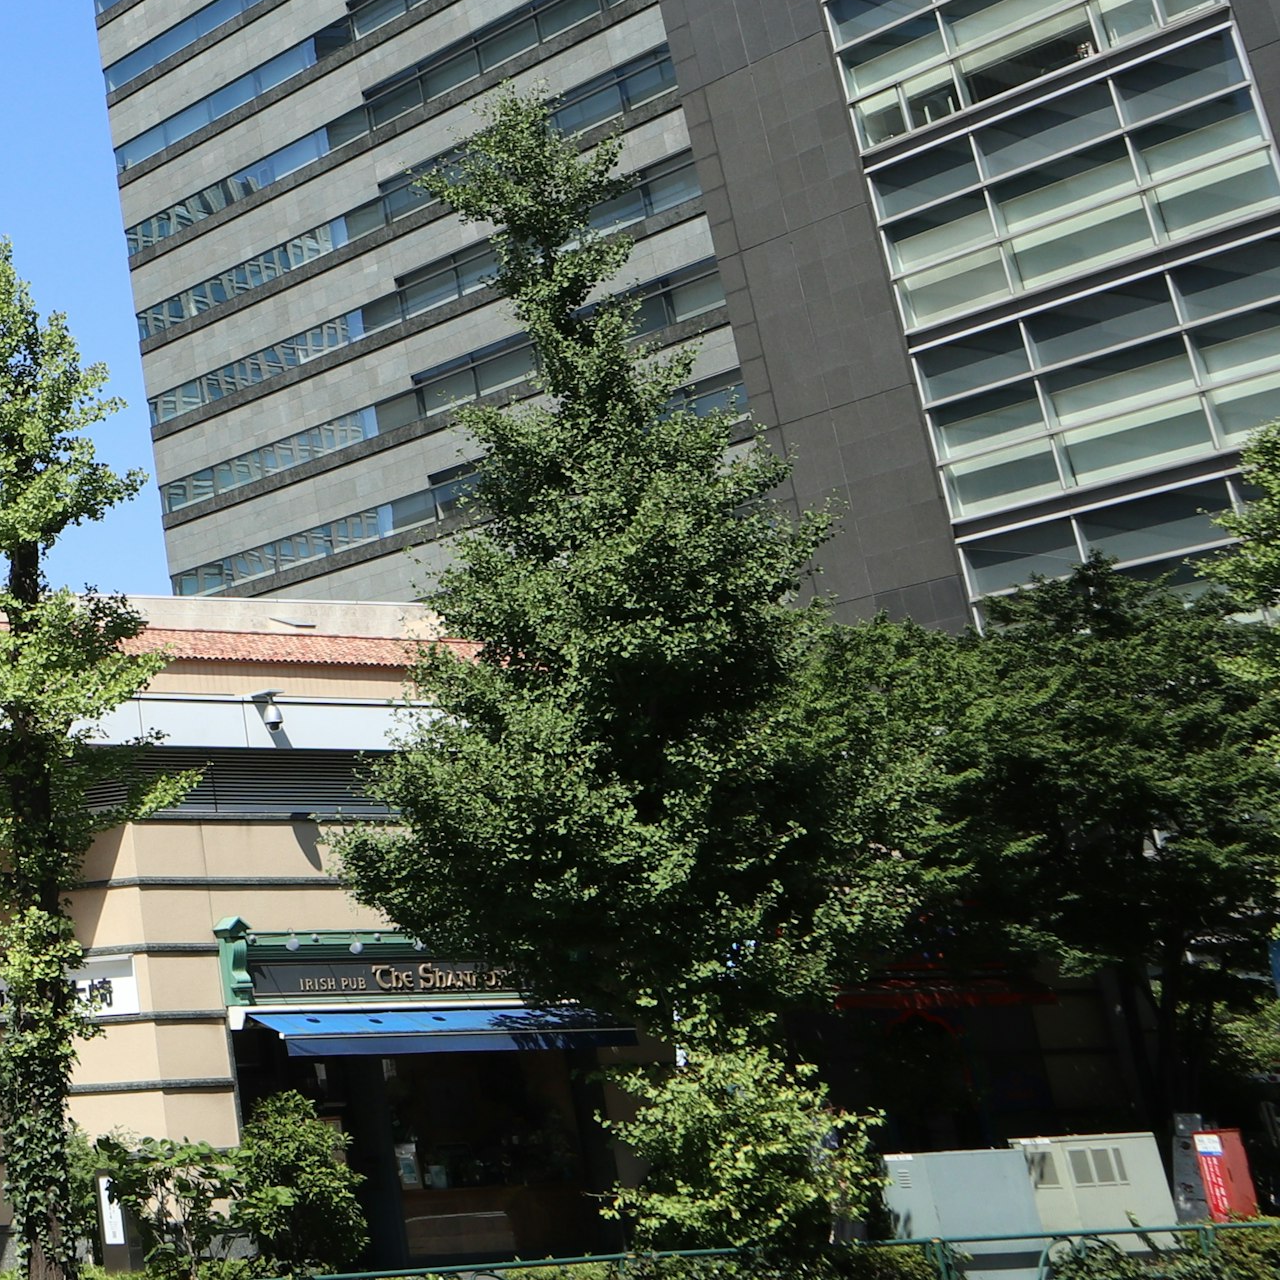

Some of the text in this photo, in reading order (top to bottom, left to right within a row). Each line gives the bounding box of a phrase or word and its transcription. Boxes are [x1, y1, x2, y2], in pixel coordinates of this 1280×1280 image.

[299, 978, 337, 991] IRISH
[341, 977, 367, 990] PUB
[371, 964, 415, 990] The
